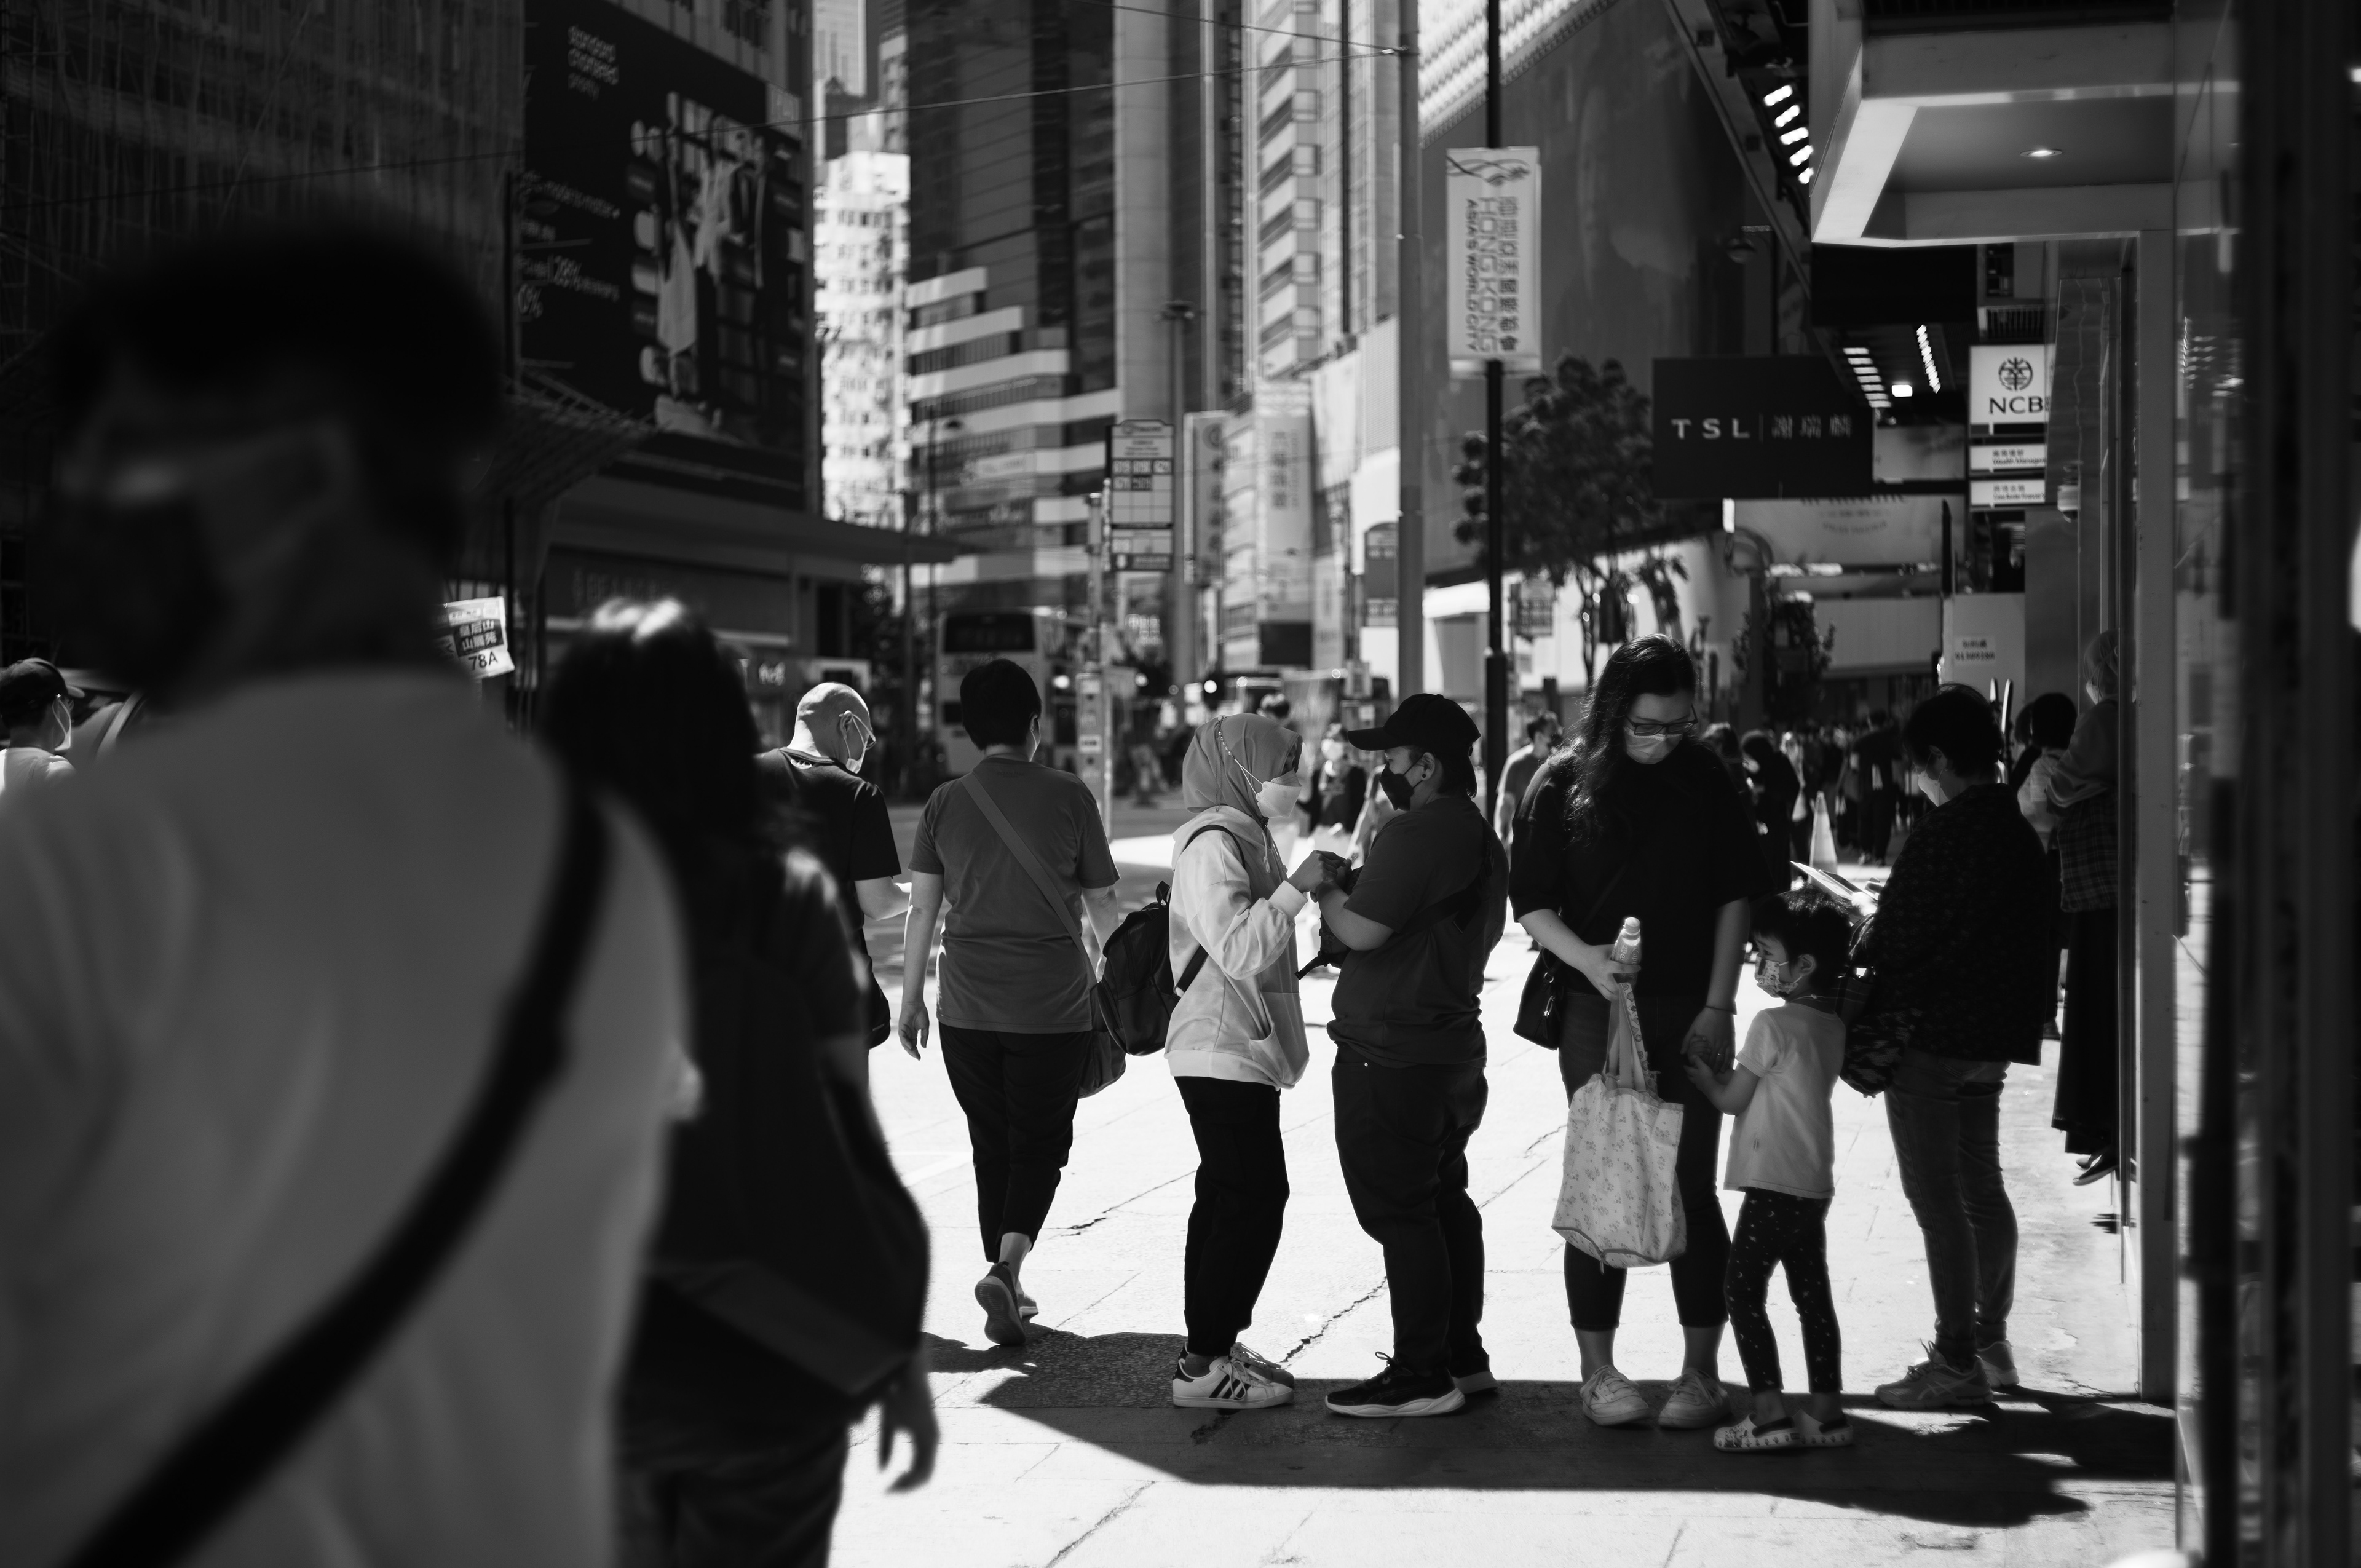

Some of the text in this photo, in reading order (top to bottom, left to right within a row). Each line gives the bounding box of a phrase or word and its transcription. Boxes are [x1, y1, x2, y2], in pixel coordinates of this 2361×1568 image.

[1466, 253, 1479, 312] WORLD
[1478, 197, 1497, 353] HONG KONG
[1466, 313, 1479, 352] CITY
[1989, 396, 2043, 415] NCB
[1671, 417, 1751, 440] TSL
[468, 651, 499, 671] 78A
